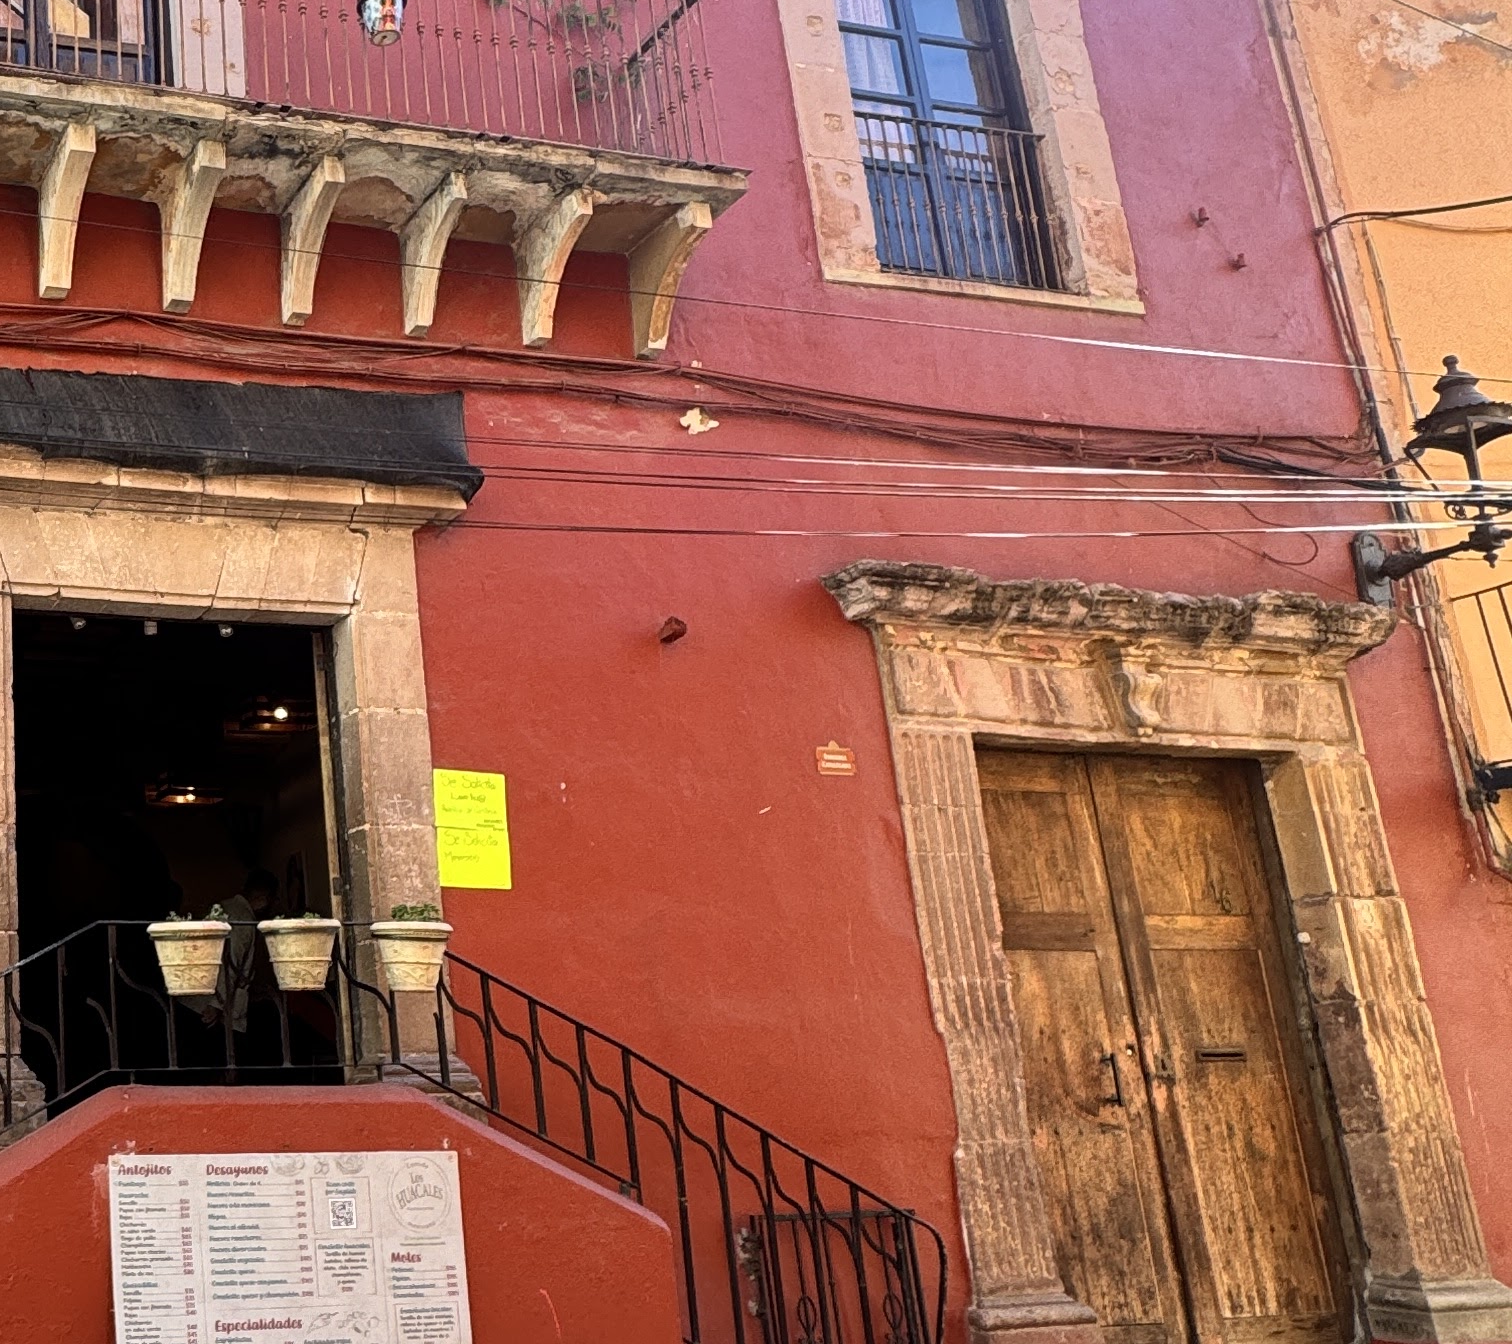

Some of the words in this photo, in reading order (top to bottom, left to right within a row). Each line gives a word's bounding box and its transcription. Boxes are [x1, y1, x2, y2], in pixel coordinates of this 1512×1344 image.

[118, 1164, 172, 1177] Antojitos
[206, 1164, 268, 1178] Desayunos
[396, 1184, 444, 1210] HUACALES
[391, 1252, 422, 1263] Moles
[215, 1318, 302, 1334] Especialidades
